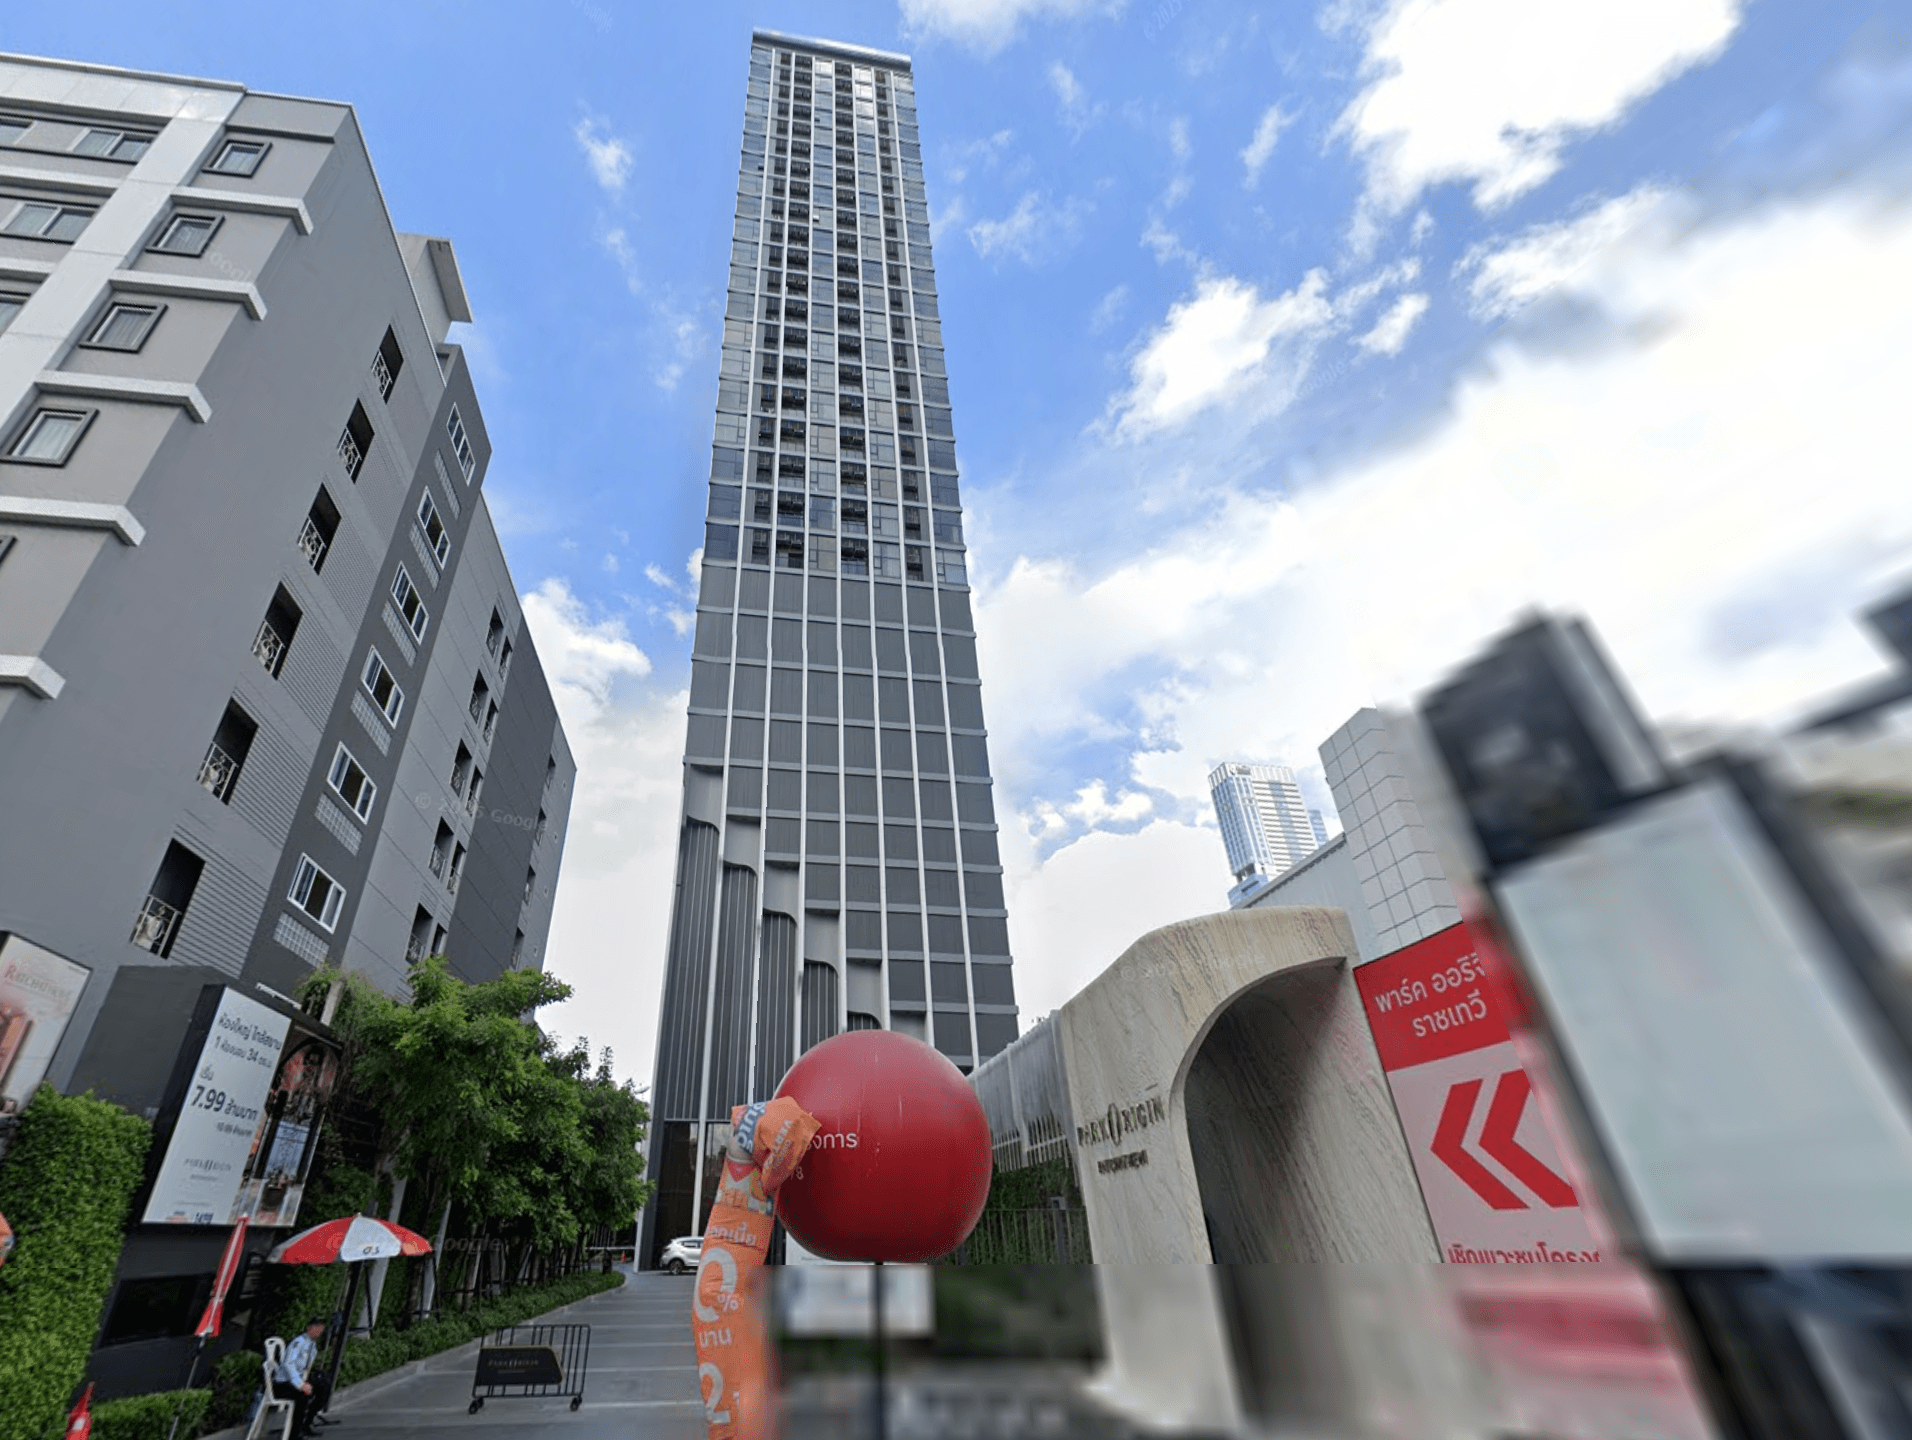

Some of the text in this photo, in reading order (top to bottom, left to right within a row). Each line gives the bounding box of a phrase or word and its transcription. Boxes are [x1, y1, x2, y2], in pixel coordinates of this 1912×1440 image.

[1375, 978, 1428, 1013] พาร์ค
[1412, 988, 1487, 1037] ราชเทวี
[191, 1085, 226, 1112] 7.99
